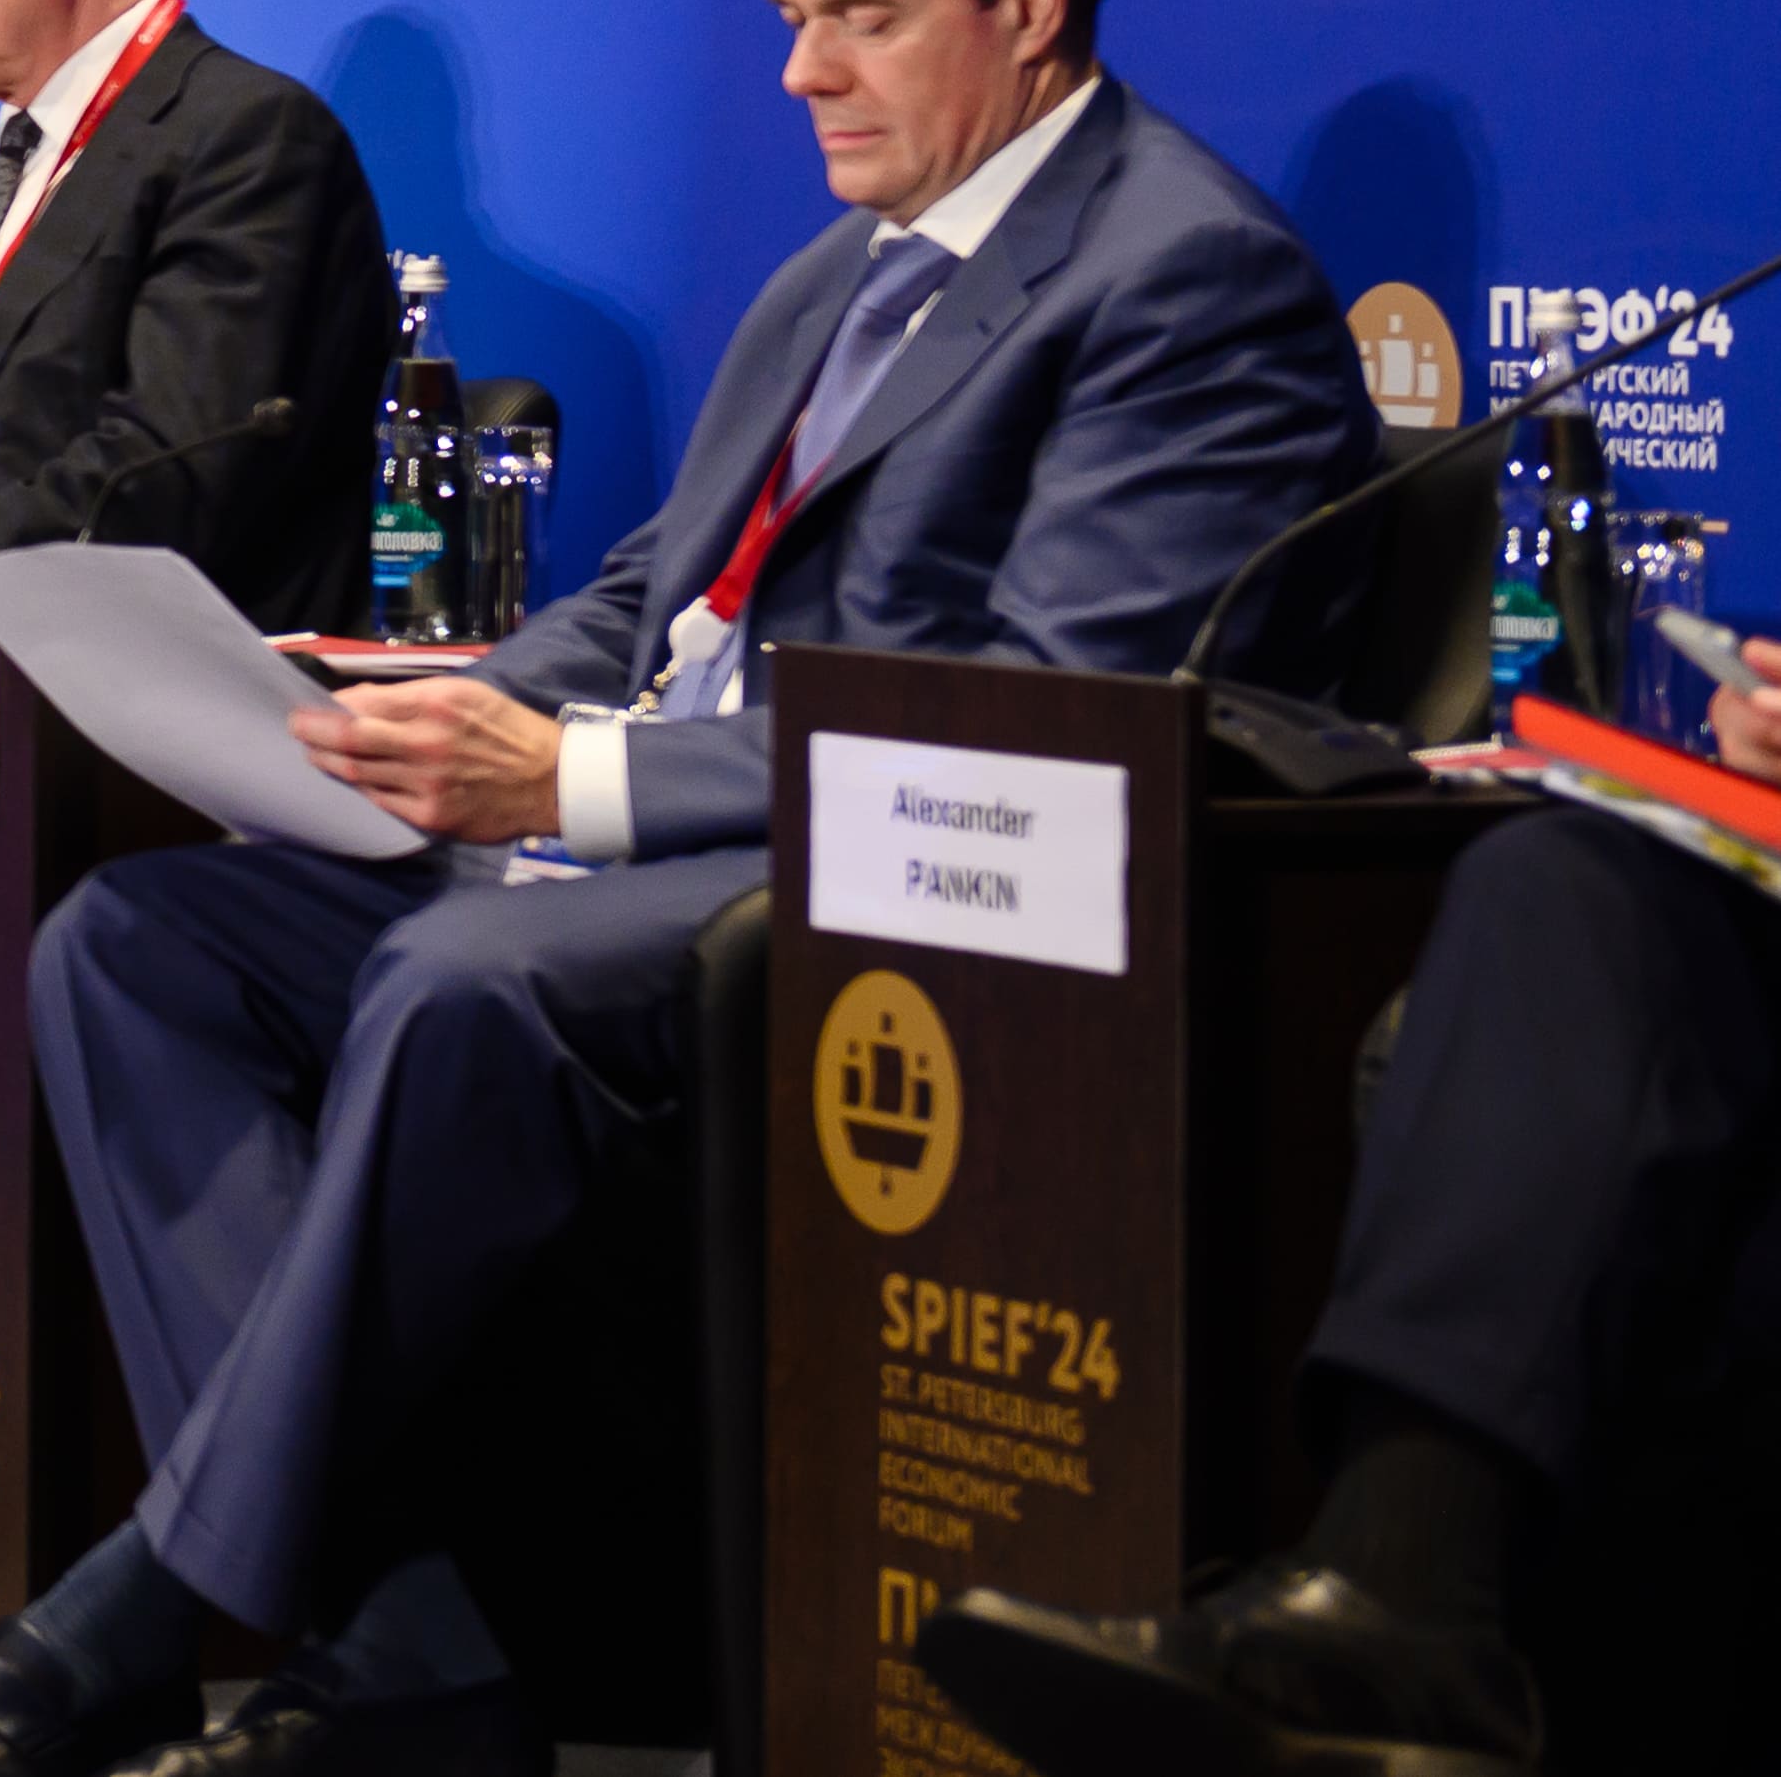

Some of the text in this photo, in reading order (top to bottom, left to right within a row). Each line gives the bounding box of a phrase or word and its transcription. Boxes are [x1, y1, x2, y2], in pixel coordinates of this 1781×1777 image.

[891, 784, 1035, 839] Alexander
[906, 858, 1020, 913] PANKIN
[880, 1272, 1121, 1402] SPIEF'24
